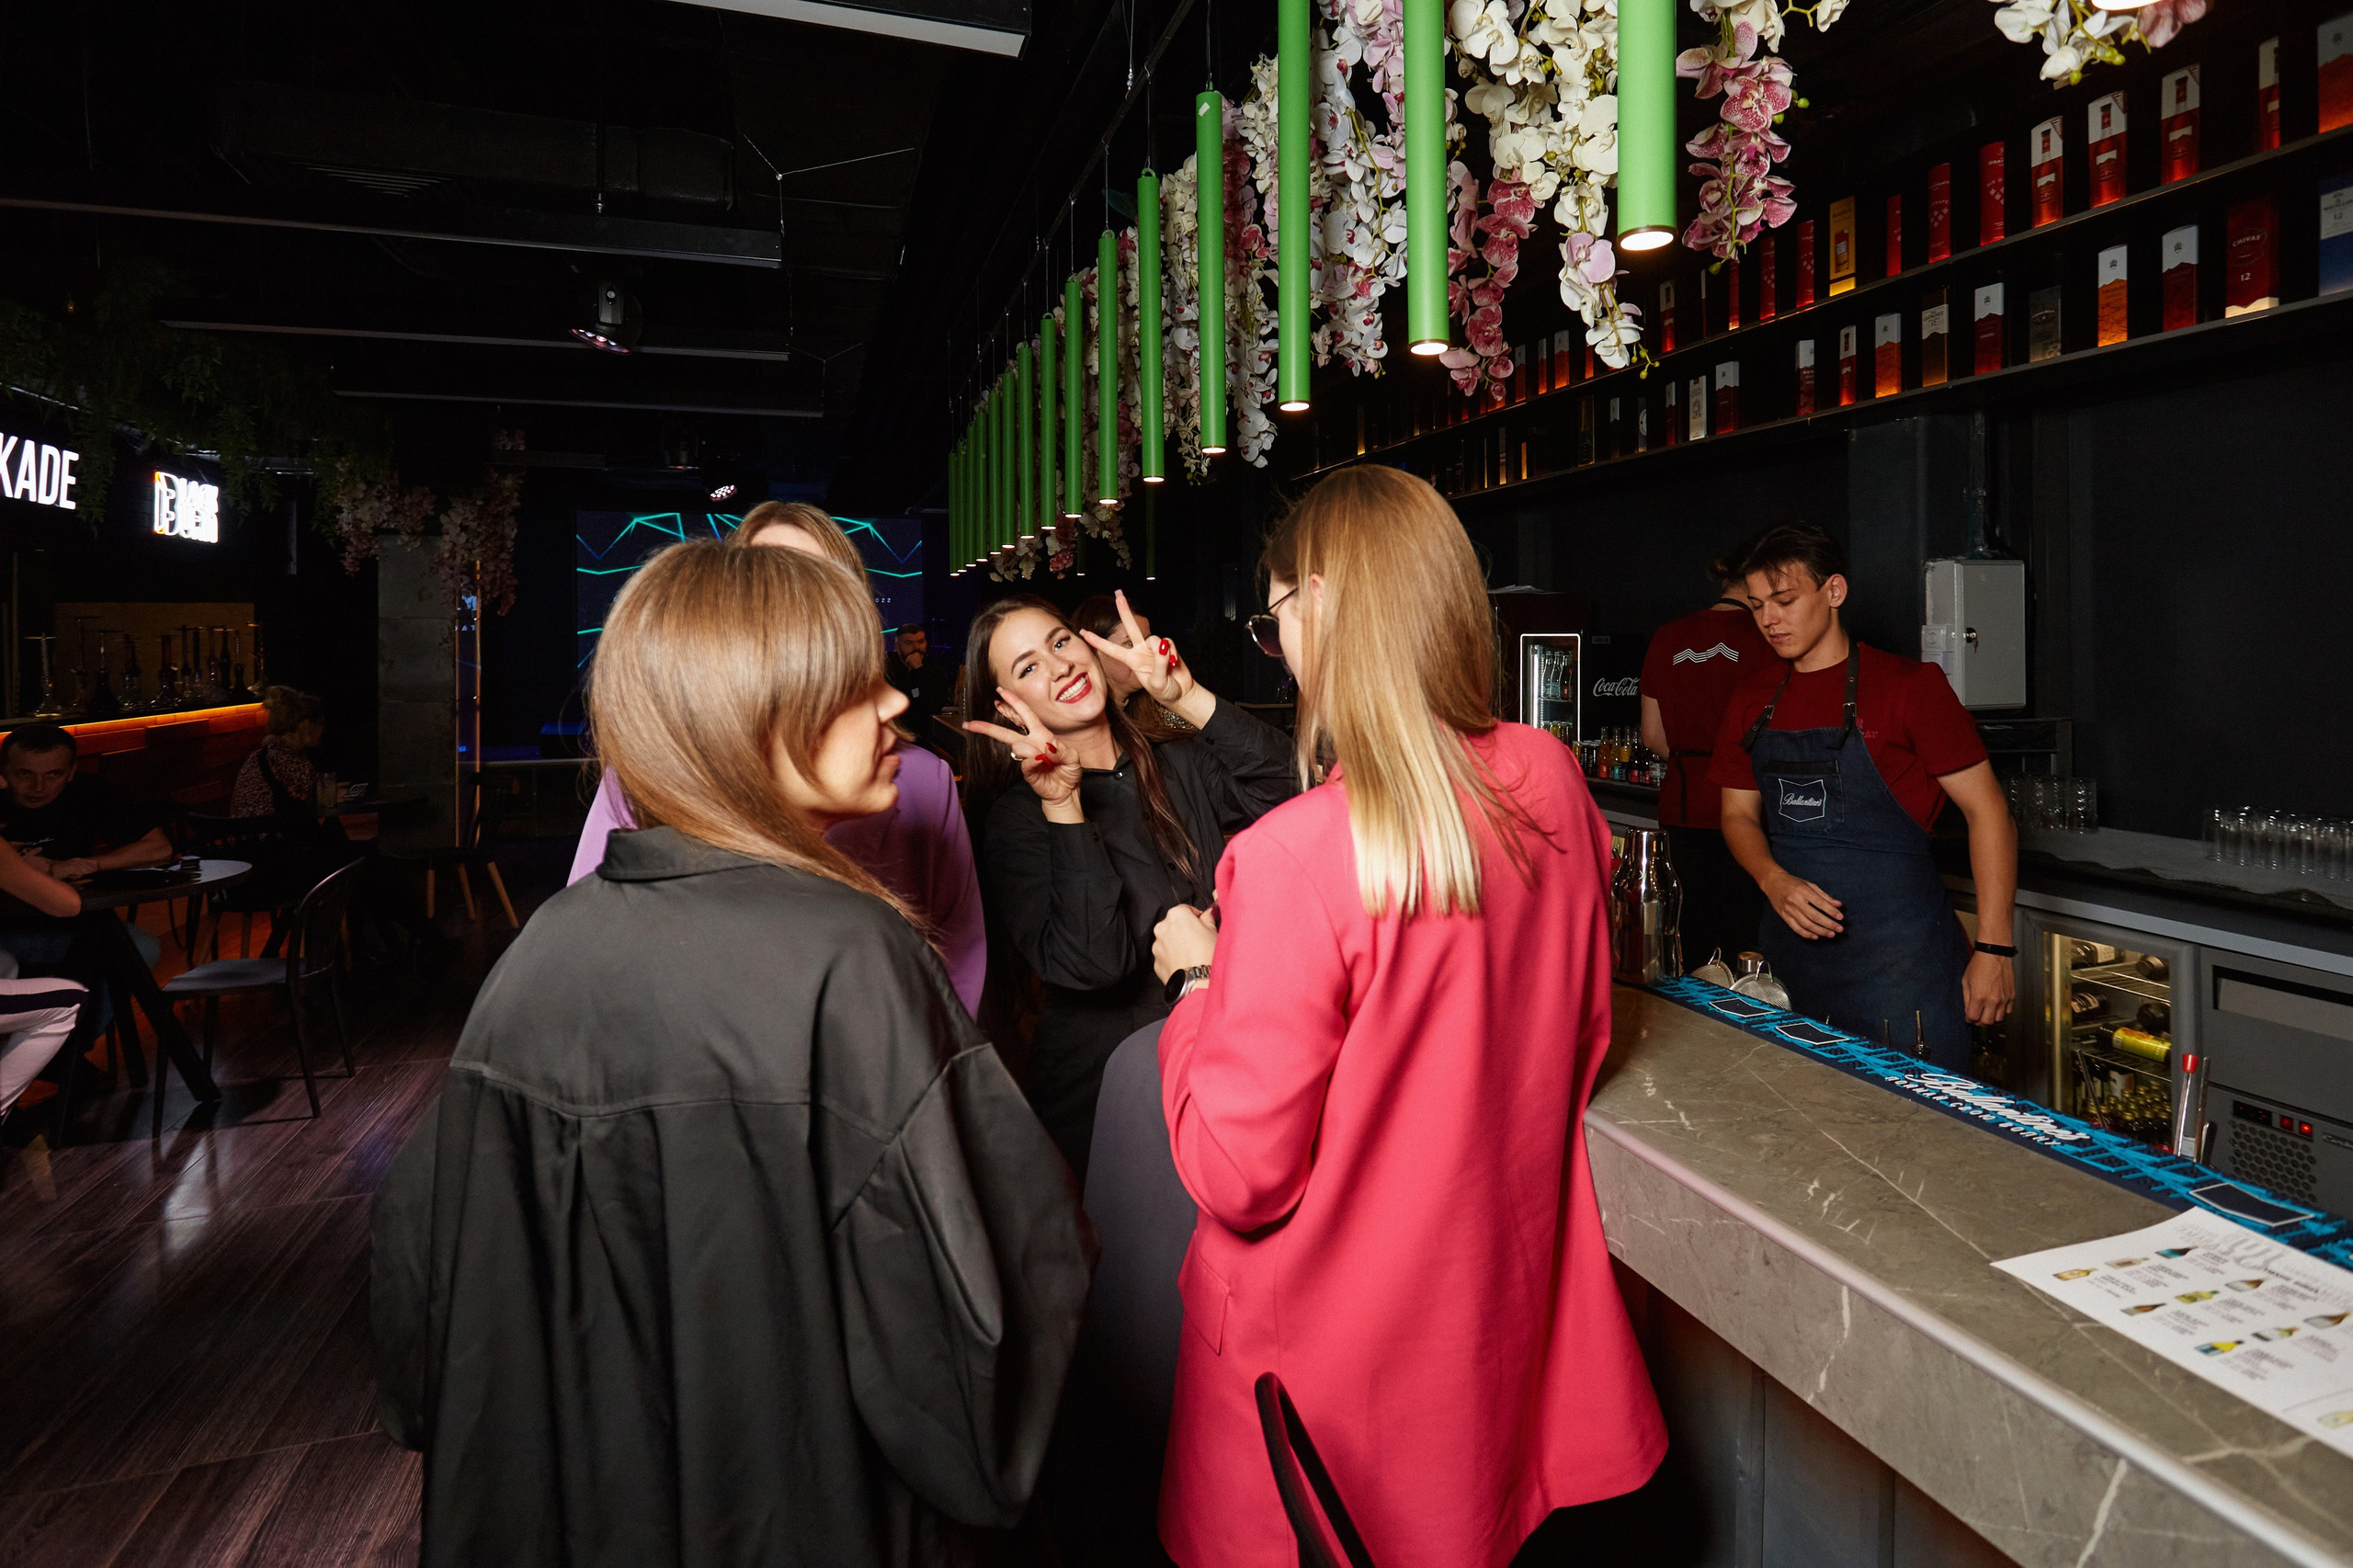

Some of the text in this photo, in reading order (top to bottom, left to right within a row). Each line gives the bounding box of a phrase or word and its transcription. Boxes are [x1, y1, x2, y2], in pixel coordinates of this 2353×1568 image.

[2232, 234, 2261, 247] CHIVAS
[2240, 272, 2251, 281] 12
[0, 432, 80, 510] KADE
[1593, 677, 1641, 698] Coca-Cola
[1782, 792, 1823, 807] Ballantine's
[1904, 1074, 2090, 1141] Ballantine's
